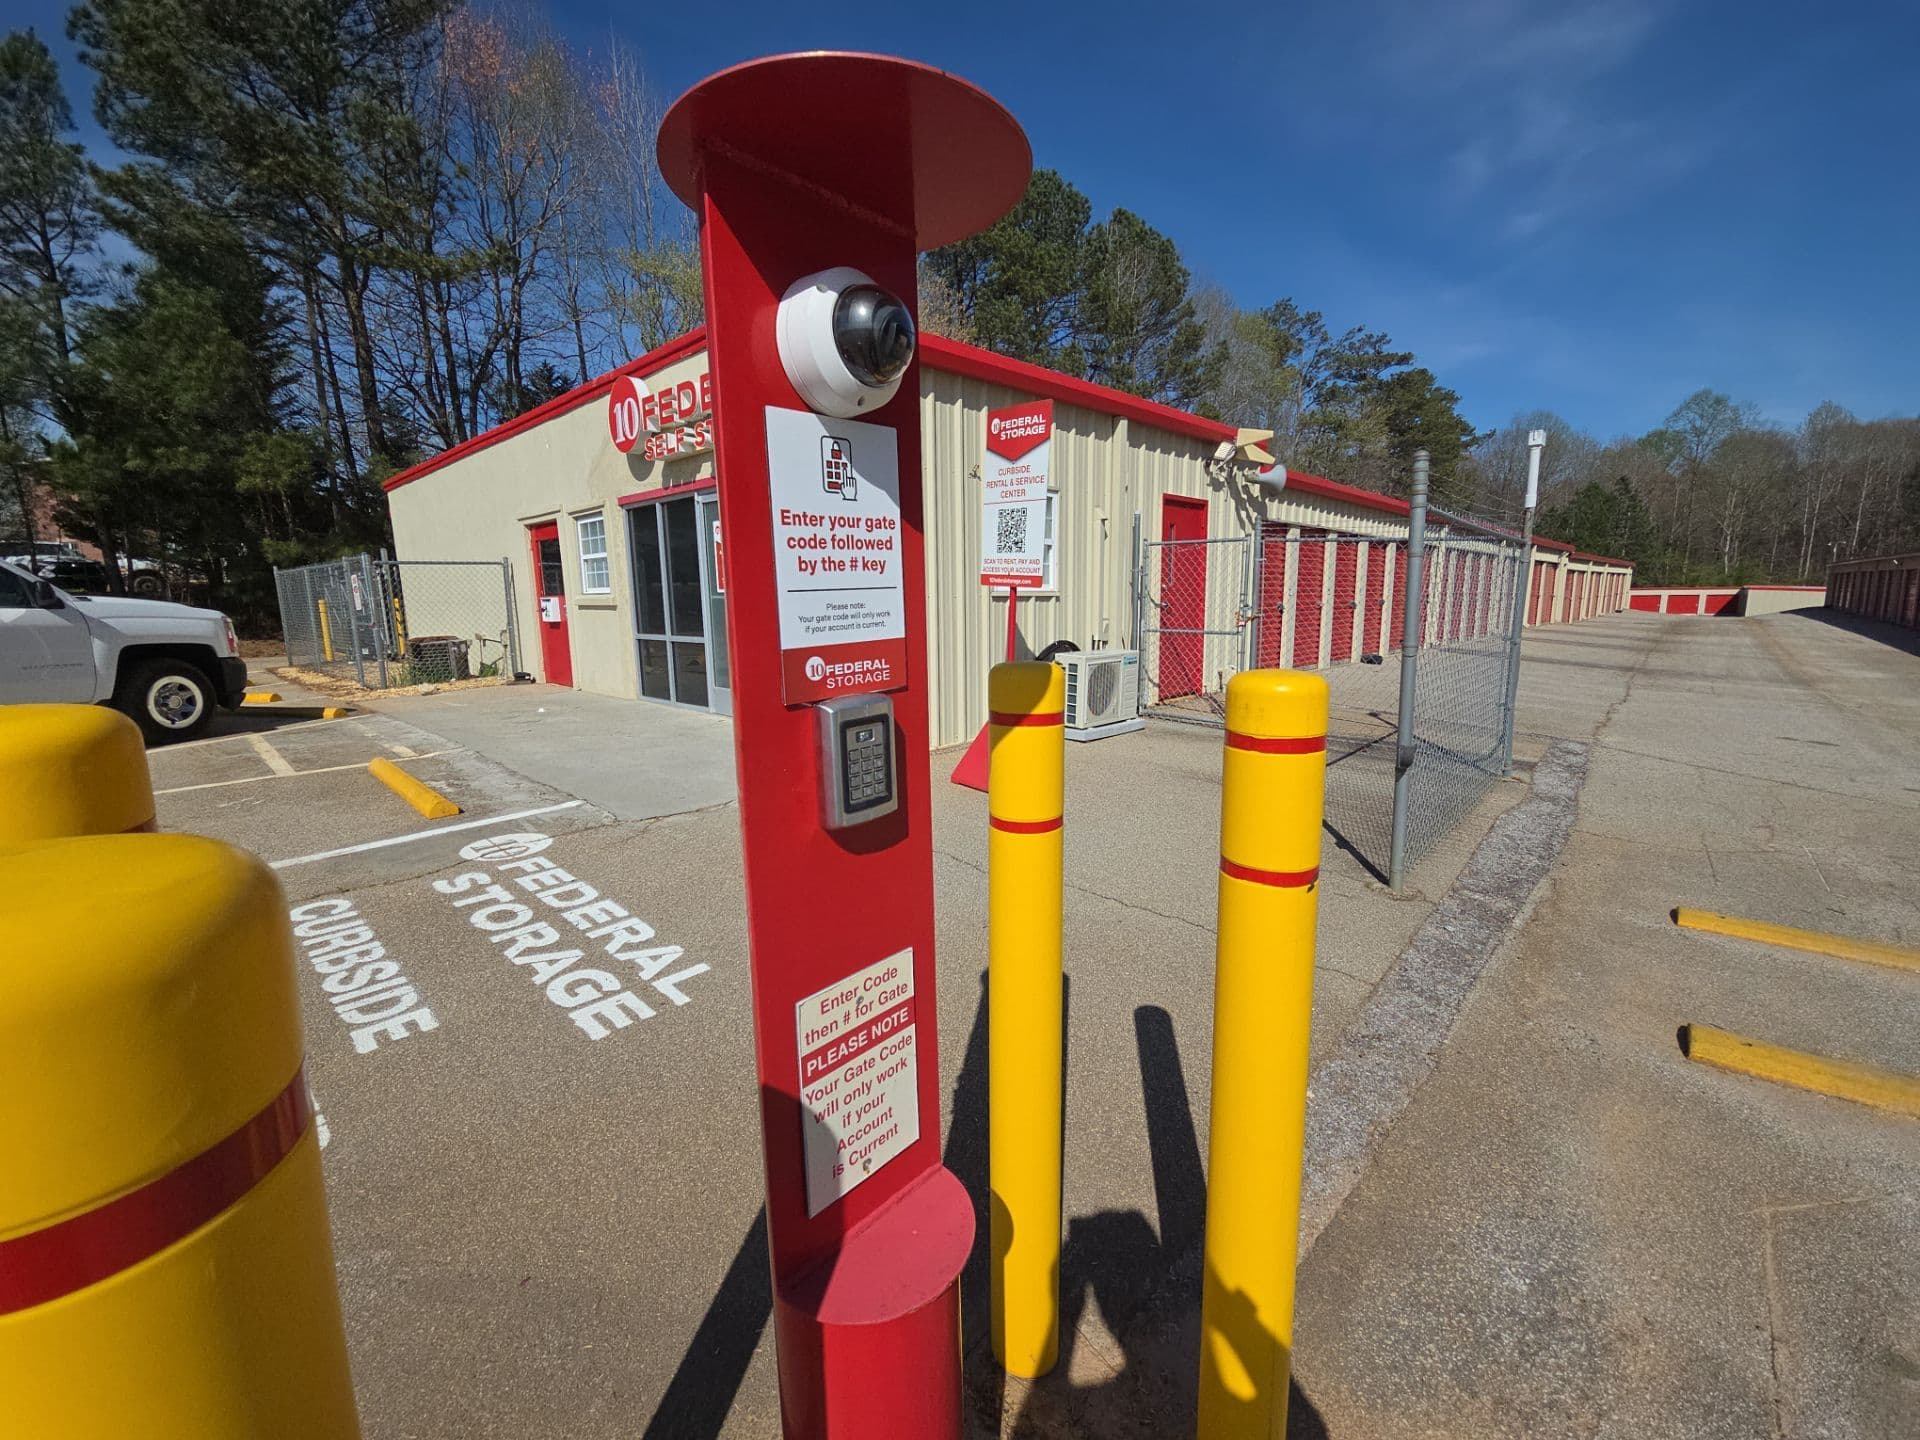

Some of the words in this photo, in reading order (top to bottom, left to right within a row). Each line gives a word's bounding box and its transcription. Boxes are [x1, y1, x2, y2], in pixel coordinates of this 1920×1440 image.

[613, 397, 640, 444] 10
[1001, 414, 1046, 430] FEDERAL
[1001, 424, 1046, 440] STORAGE
[644, 427, 685, 461] SELF
[986, 478, 1008, 489] RENTAL
[1009, 478, 1014, 486] &
[1015, 475, 1045, 486] SERVICE
[998, 465, 1031, 476] CURBSIDE
[1001, 489, 1026, 498] CENTER
[780, 509, 825, 527] Enter
[828, 515, 861, 531] your
[865, 516, 896, 533] gate
[787, 533, 827, 549] code
[831, 534, 893, 550] followed
[798, 555, 817, 576] by
[821, 556, 846, 571] the
[849, 556, 858, 571] #
[862, 556, 886, 574] key
[798, 615, 814, 623] Your
[815, 614, 831, 624] gate
[833, 612, 849, 621] code
[850, 611, 861, 619] will
[862, 610, 875, 620] only
[876, 609, 890, 618] work
[826, 603, 849, 611] Please
[850, 602, 866, 610] note:
[811, 626, 827, 634] your
[828, 623, 855, 632] account
[809, 664, 824, 678] 10
[826, 659, 890, 676] FEDERAL
[826, 670, 890, 689] STORAGE
[498, 856, 710, 1006] FEDERAL
[432, 871, 657, 1041] STORAGE
[290, 898, 439, 1054] CURBSIDE
[820, 986, 859, 1015] Enter
[863, 967, 898, 992] Code
[805, 1020, 838, 1046] then
[843, 1010, 851, 1025] #
[855, 999, 874, 1018] for
[878, 983, 908, 1006] Gate
[806, 1030, 868, 1077] PLEASE
[871, 1007, 909, 1040] NOTE
[805, 1078, 840, 1106] Your
[843, 1057, 875, 1083] Gate
[880, 1034, 912, 1062] Code
[814, 1098, 839, 1124] will
[843, 1079, 873, 1106] only
[876, 1057, 908, 1084] work
[842, 1111, 852, 1128] if
[855, 1092, 885, 1123] your
[837, 1106, 893, 1154] Account
[832, 1164, 845, 1179] is
[848, 1123, 899, 1166] Current
